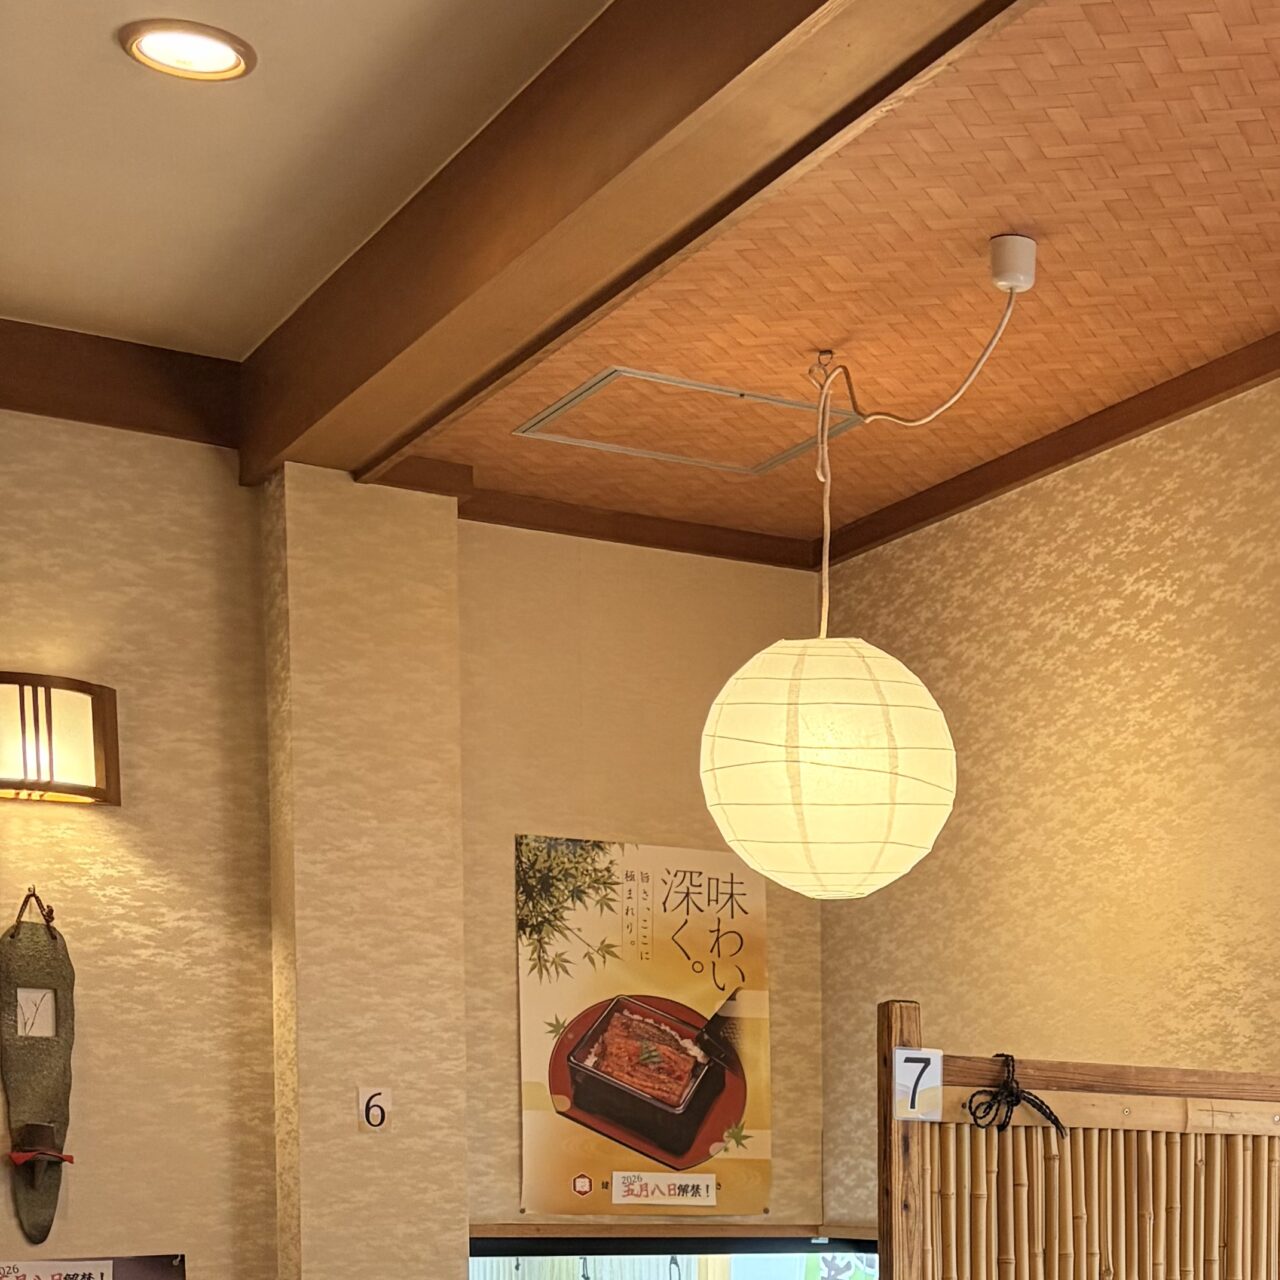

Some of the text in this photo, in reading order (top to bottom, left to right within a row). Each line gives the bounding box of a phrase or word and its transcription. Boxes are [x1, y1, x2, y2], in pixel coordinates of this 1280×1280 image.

[625, 870, 636, 946] 極まれり。
[640, 871, 651, 960] 旨さ、ここに
[661, 868, 704, 973] 深く。
[706, 872, 749, 991] 味わい
[365, 1092, 385, 1127] 6
[903, 1056, 931, 1109] 7
[622, 1174, 642, 1184] 2026
